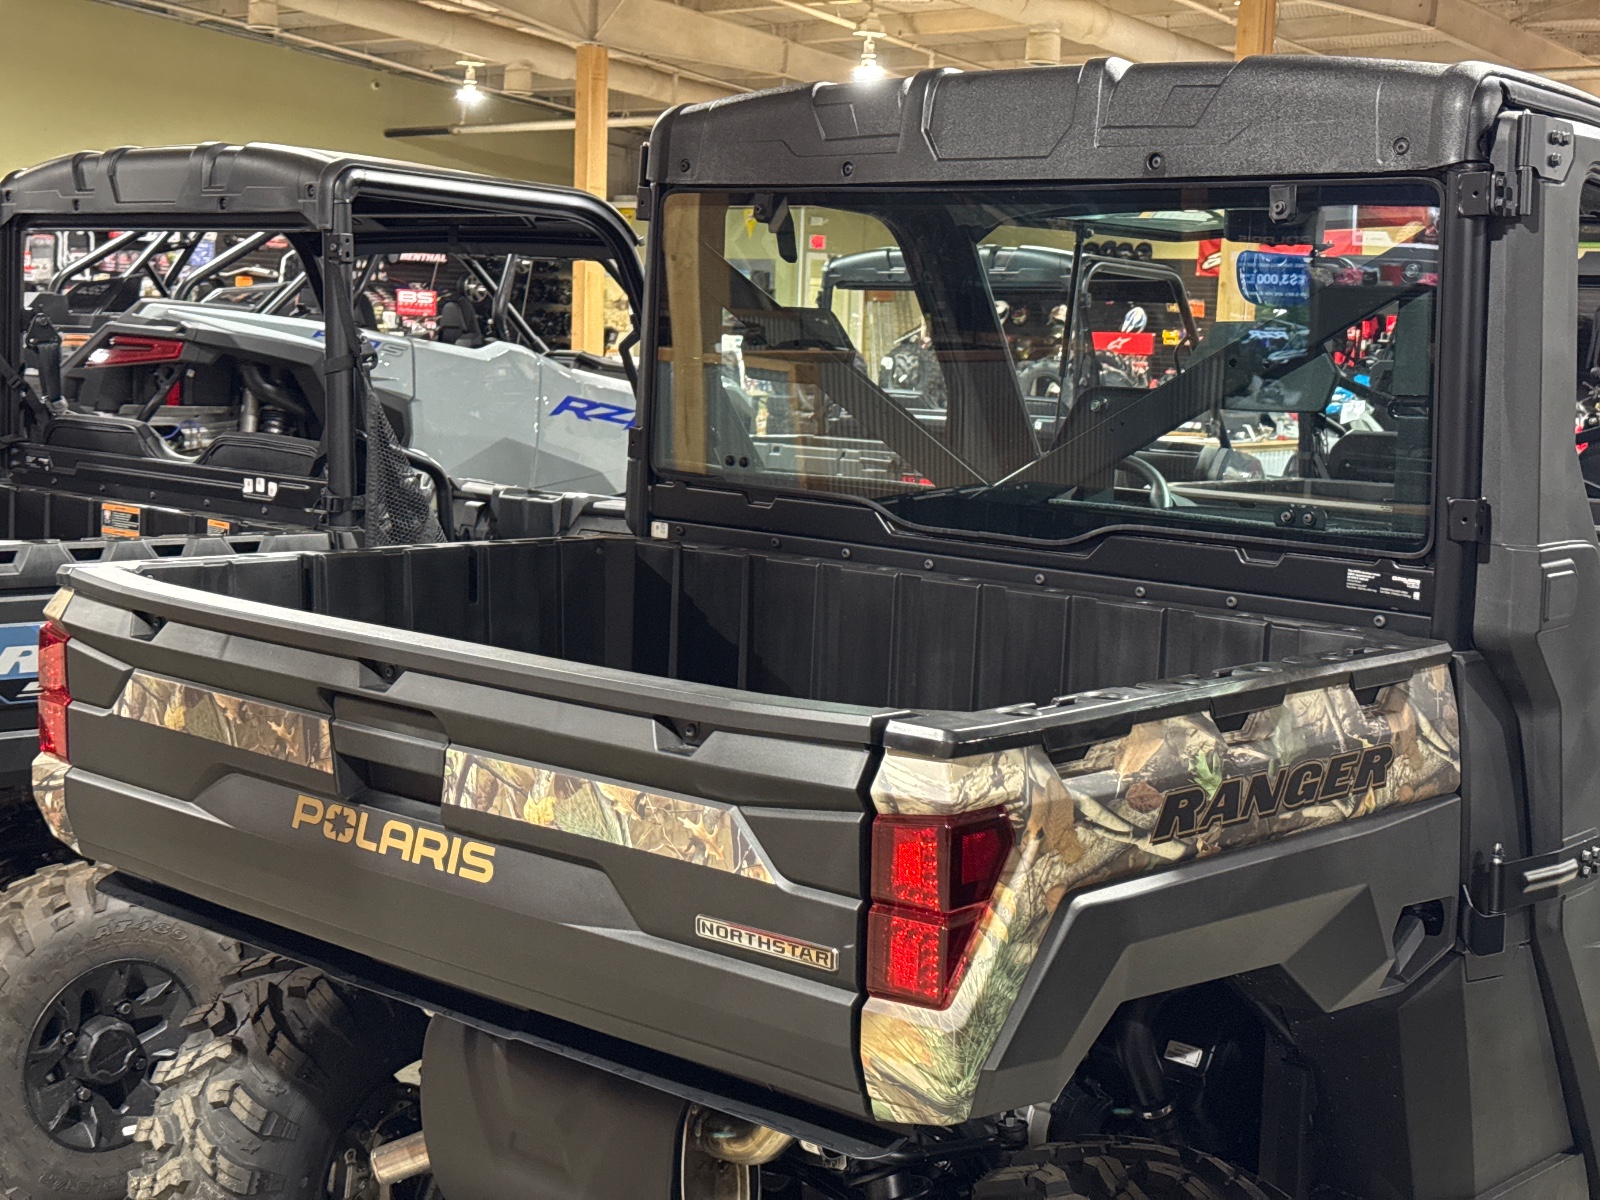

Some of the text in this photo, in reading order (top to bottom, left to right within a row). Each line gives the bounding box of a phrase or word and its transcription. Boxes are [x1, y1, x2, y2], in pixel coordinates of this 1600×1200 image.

[398, 290, 435, 303] BS
[548, 395, 636, 430] RZ
[1150, 742, 1395, 844] RANGER
[291, 794, 496, 884] POLARIS
[701, 920, 830, 967] NORTHSTAR
